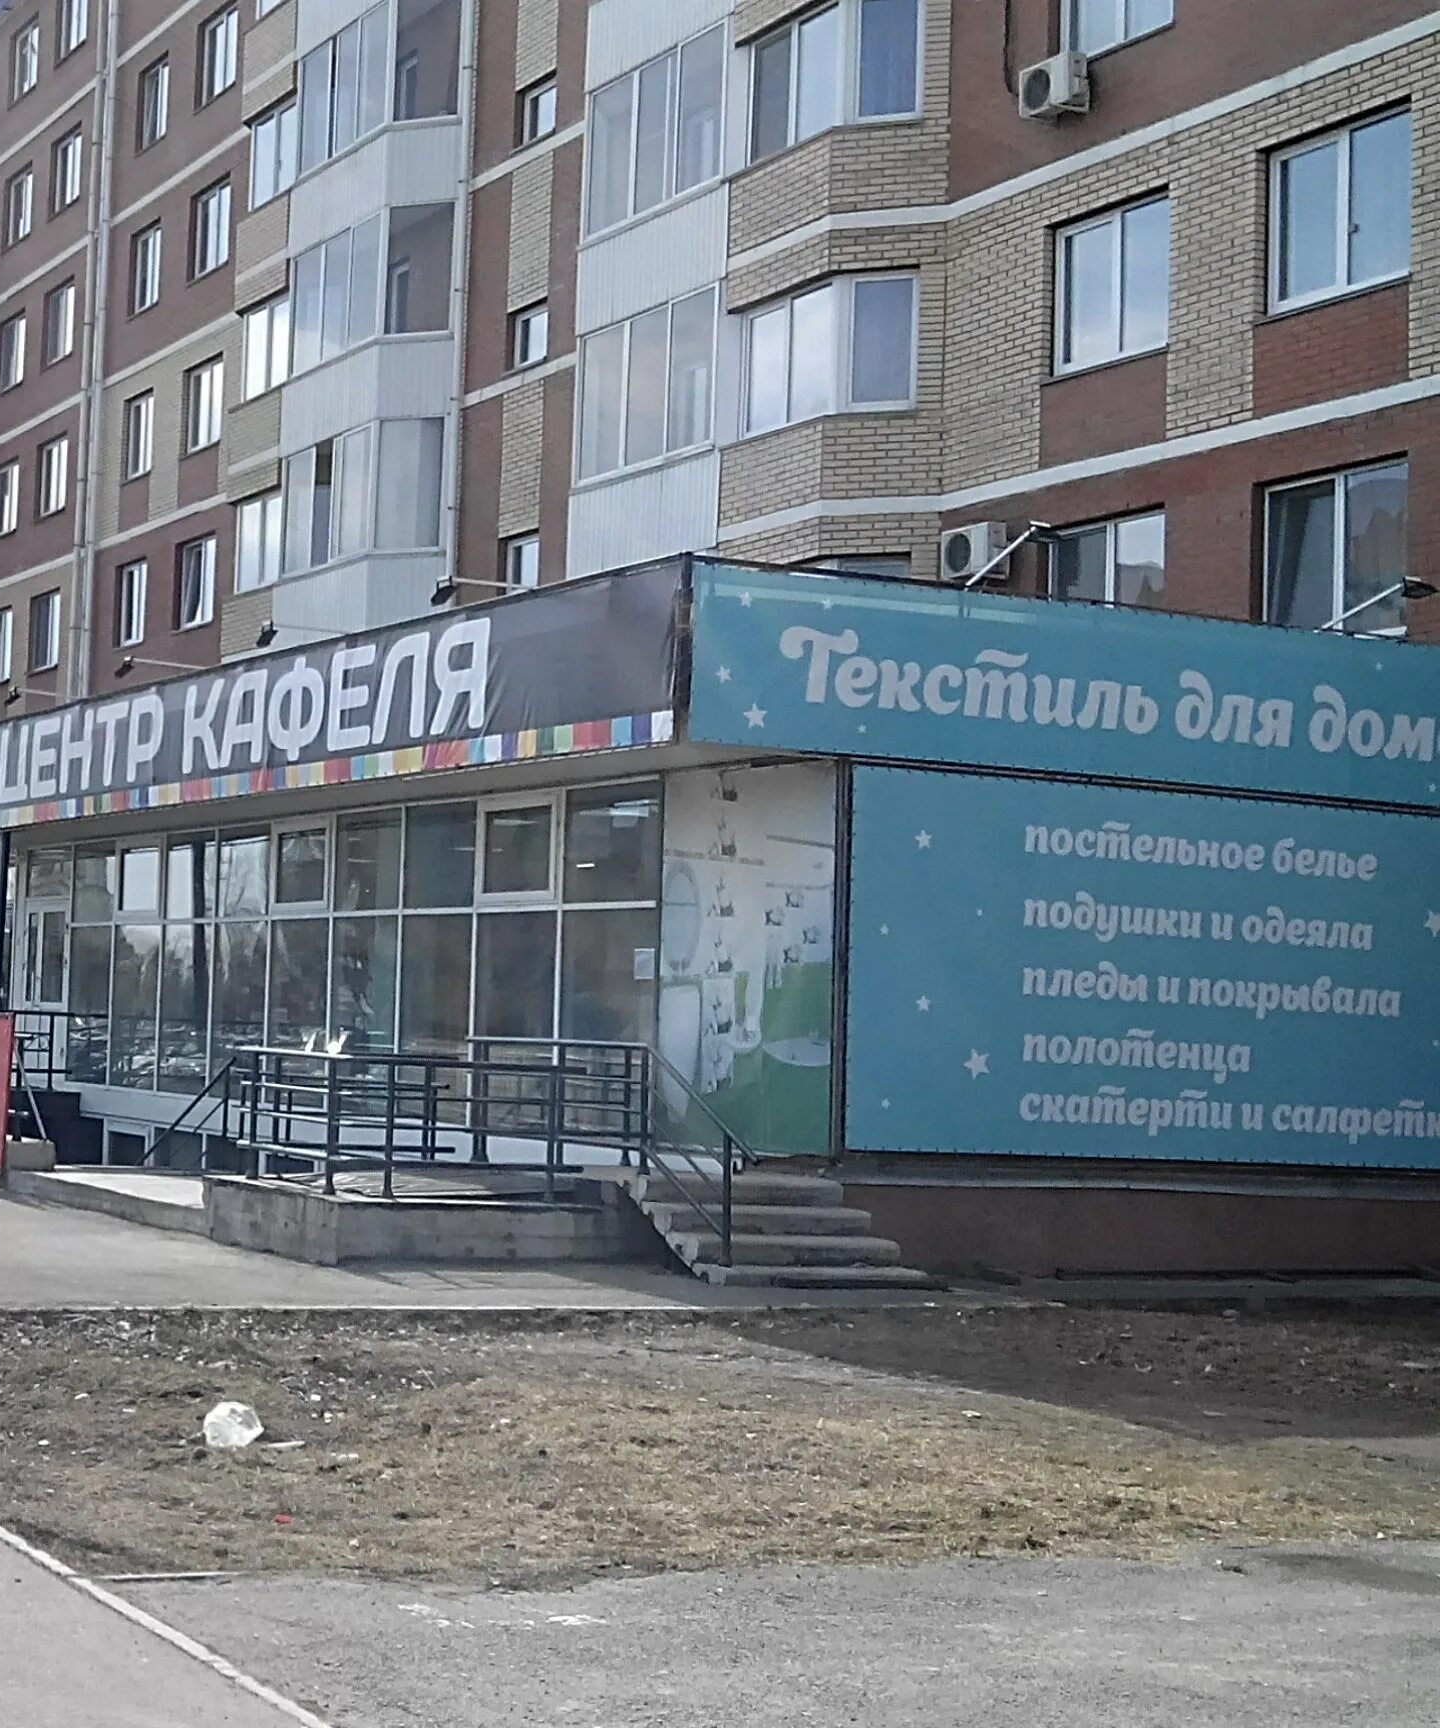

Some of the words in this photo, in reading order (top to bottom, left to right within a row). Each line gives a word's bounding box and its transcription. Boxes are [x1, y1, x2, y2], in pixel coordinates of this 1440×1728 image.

[182, 617, 492, 774] КАФЕЛЯ
[779, 626, 1159, 735] Текстиль
[1175, 670, 1293, 748] для
[1308, 685, 1440, 762] дом
[1024, 820, 1265, 873] постельное
[1272, 838, 1378, 881] белье
[1023, 891, 1202, 942] подушки
[1211, 910, 1233, 941] и
[1241, 906, 1374, 951] одеяла
[1022, 961, 1148, 1002] пледы
[1158, 976, 1181, 1005] и
[1189, 977, 1402, 1018] покрывала
[1023, 1028, 1251, 1084] полотенца
[1019, 1086, 1232, 1136] скатерти
[1241, 1103, 1263, 1132] и
